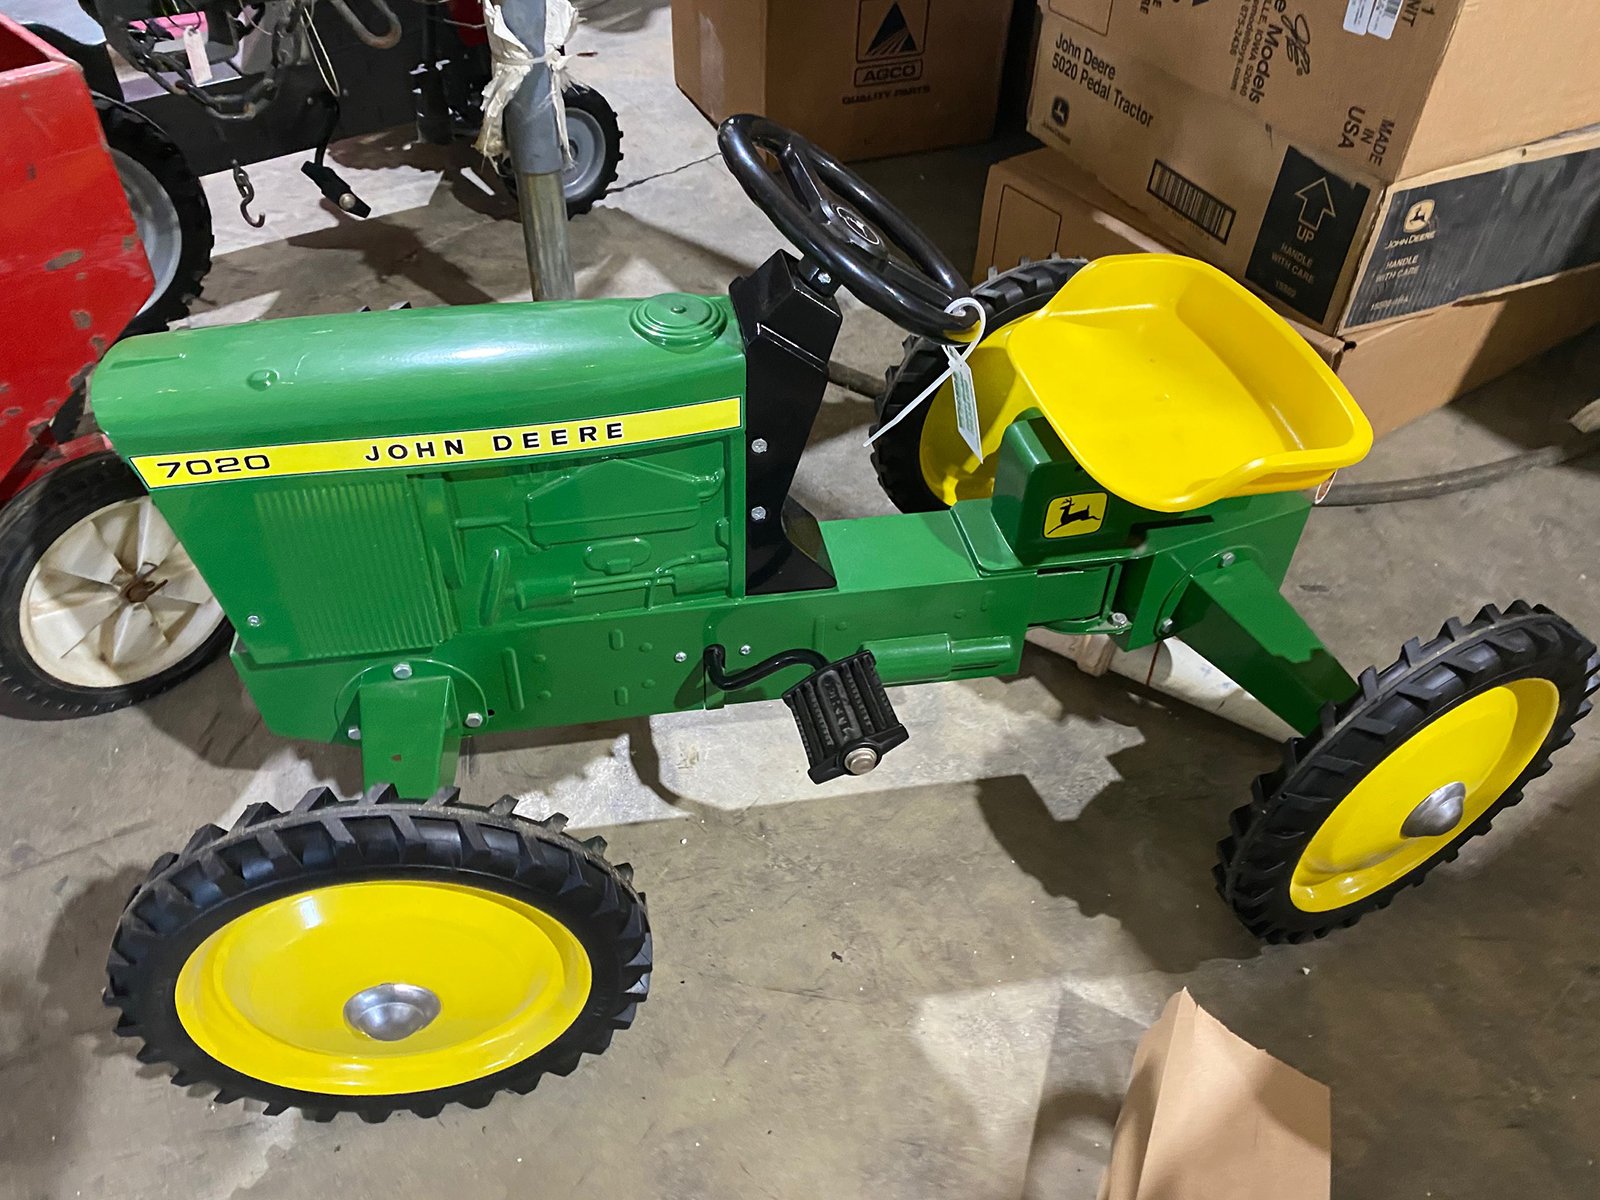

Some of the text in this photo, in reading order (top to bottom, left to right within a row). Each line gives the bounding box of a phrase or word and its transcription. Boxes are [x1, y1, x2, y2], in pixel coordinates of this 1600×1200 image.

[1402, 0, 1421, 27] NIT
[1421, 6, 1435, 15] 1
[1055, 32, 1116, 80] John Deere
[1248, 29, 1264, 61] IOWA
[863, 65, 916, 82] AGCO
[1249, 23, 1283, 104] Models
[1051, 53, 1154, 128] 5020 Pedal Tractor
[1240, 64, 1254, 97] 52040
[842, 85, 930, 105] QUALITY PARTS
[1338, 106, 1366, 148] USA
[1360, 128, 1375, 145] IN
[1369, 118, 1395, 167] MADE
[1296, 225, 1315, 243] UP
[1384, 230, 1438, 250] JOHN DEERE
[1271, 251, 1315, 285] WITH CARE
[1280, 242, 1313, 268] HANDLE
[1386, 254, 1419, 270] HANDLE
[1376, 265, 1420, 283] WITH CARE
[157, 422, 623, 479] 7020 JOHN DEERE
